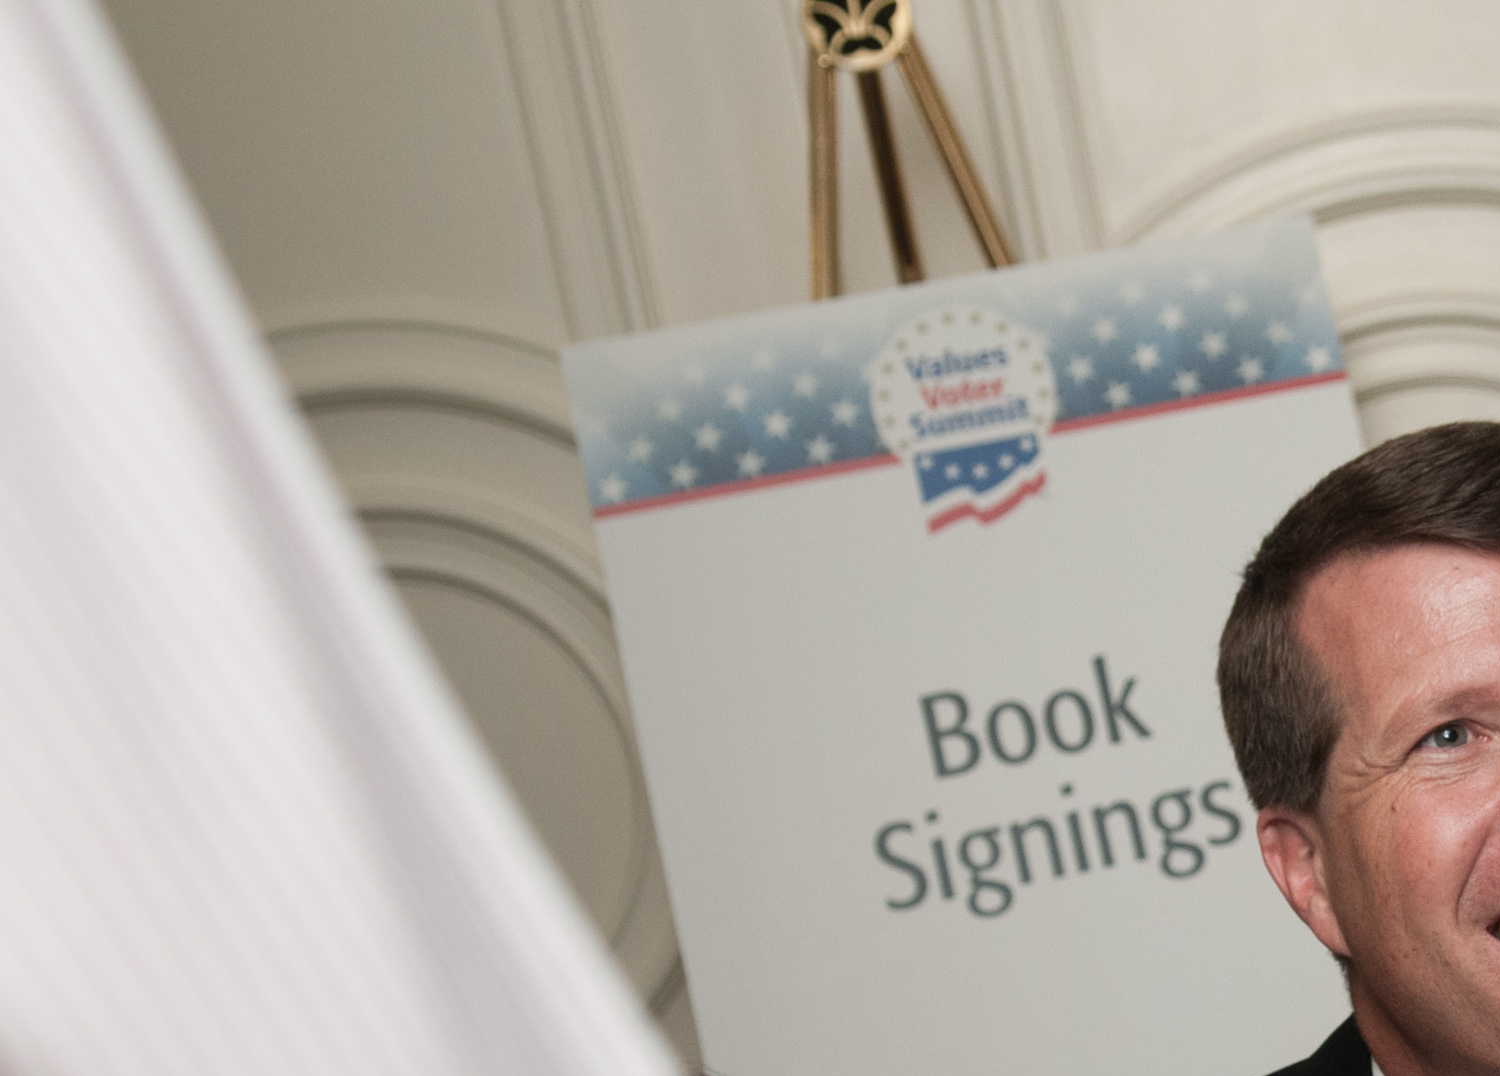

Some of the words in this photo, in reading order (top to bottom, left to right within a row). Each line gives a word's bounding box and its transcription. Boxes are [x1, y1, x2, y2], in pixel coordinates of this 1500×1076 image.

[905, 346, 1008, 380] Values
[919, 376, 1004, 410] Voter
[909, 397, 1029, 438] Summit
[919, 653, 1152, 778] Book
[873, 779, 1242, 918] Signings
